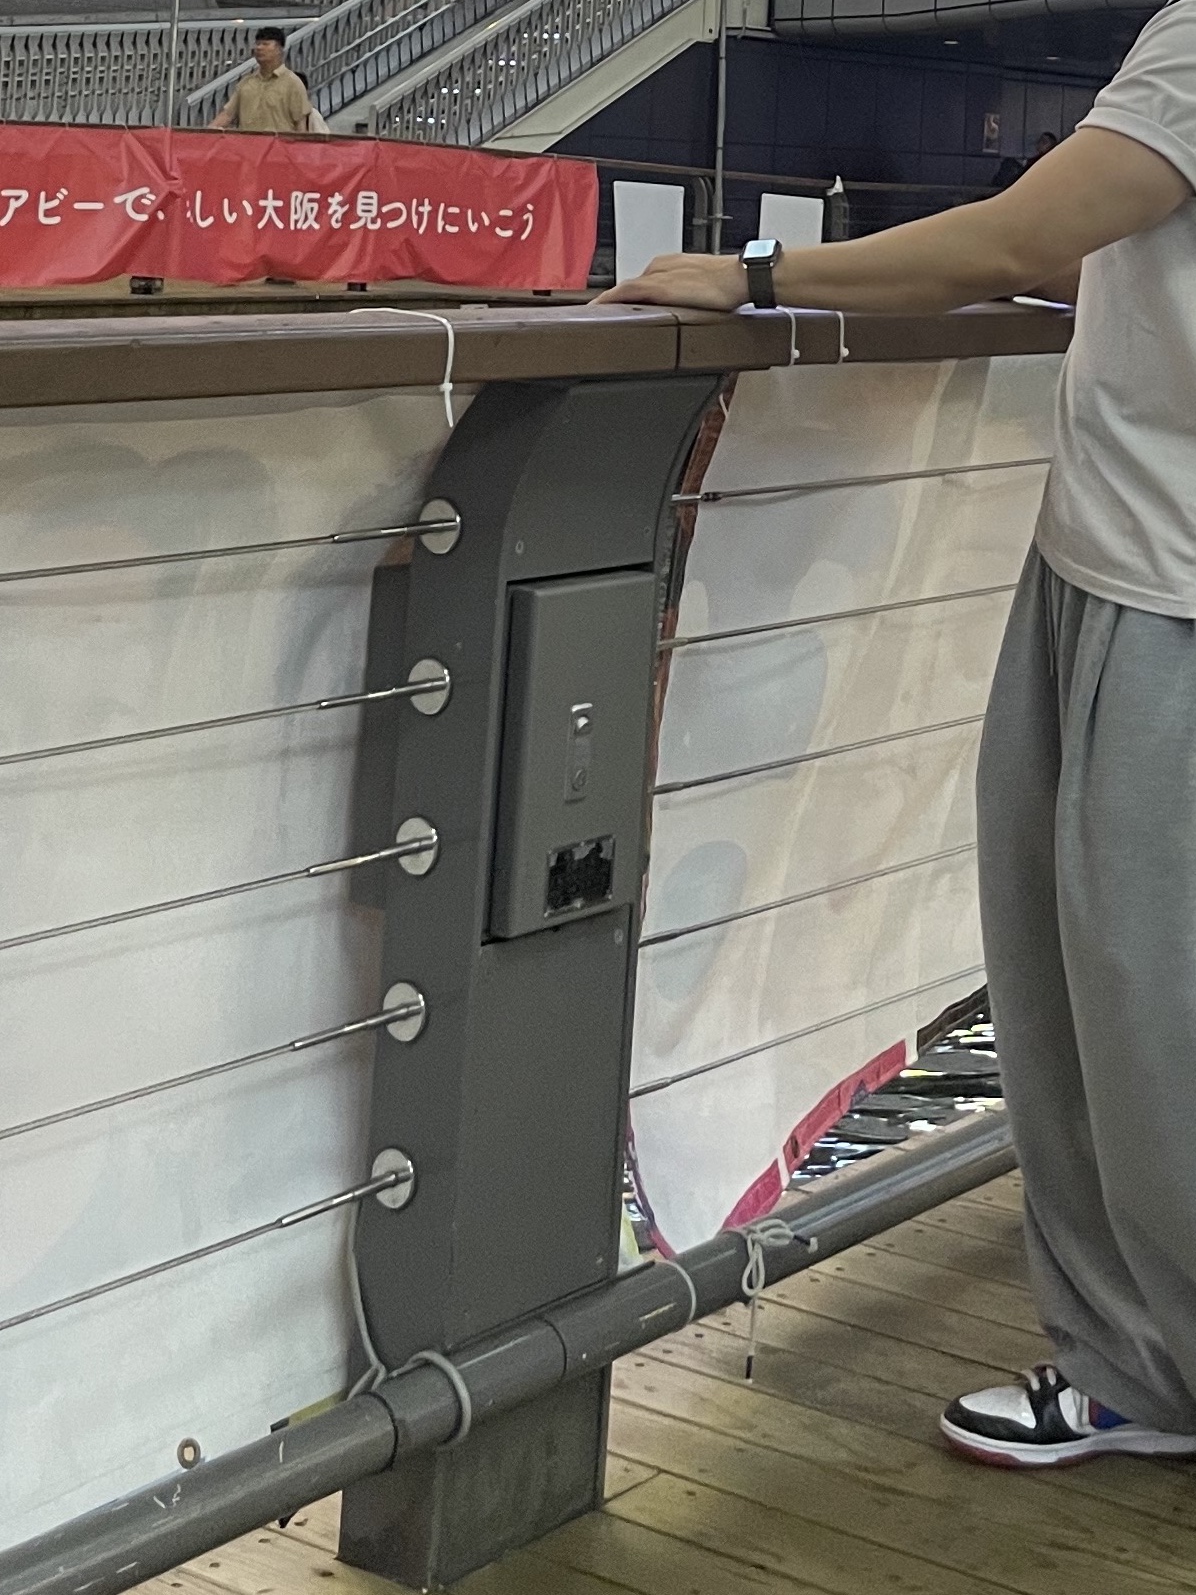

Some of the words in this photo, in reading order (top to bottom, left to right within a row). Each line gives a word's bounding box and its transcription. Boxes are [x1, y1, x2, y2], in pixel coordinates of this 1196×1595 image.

[0, 187, 536, 241] アビーでしい大阪を見つけにいこう
